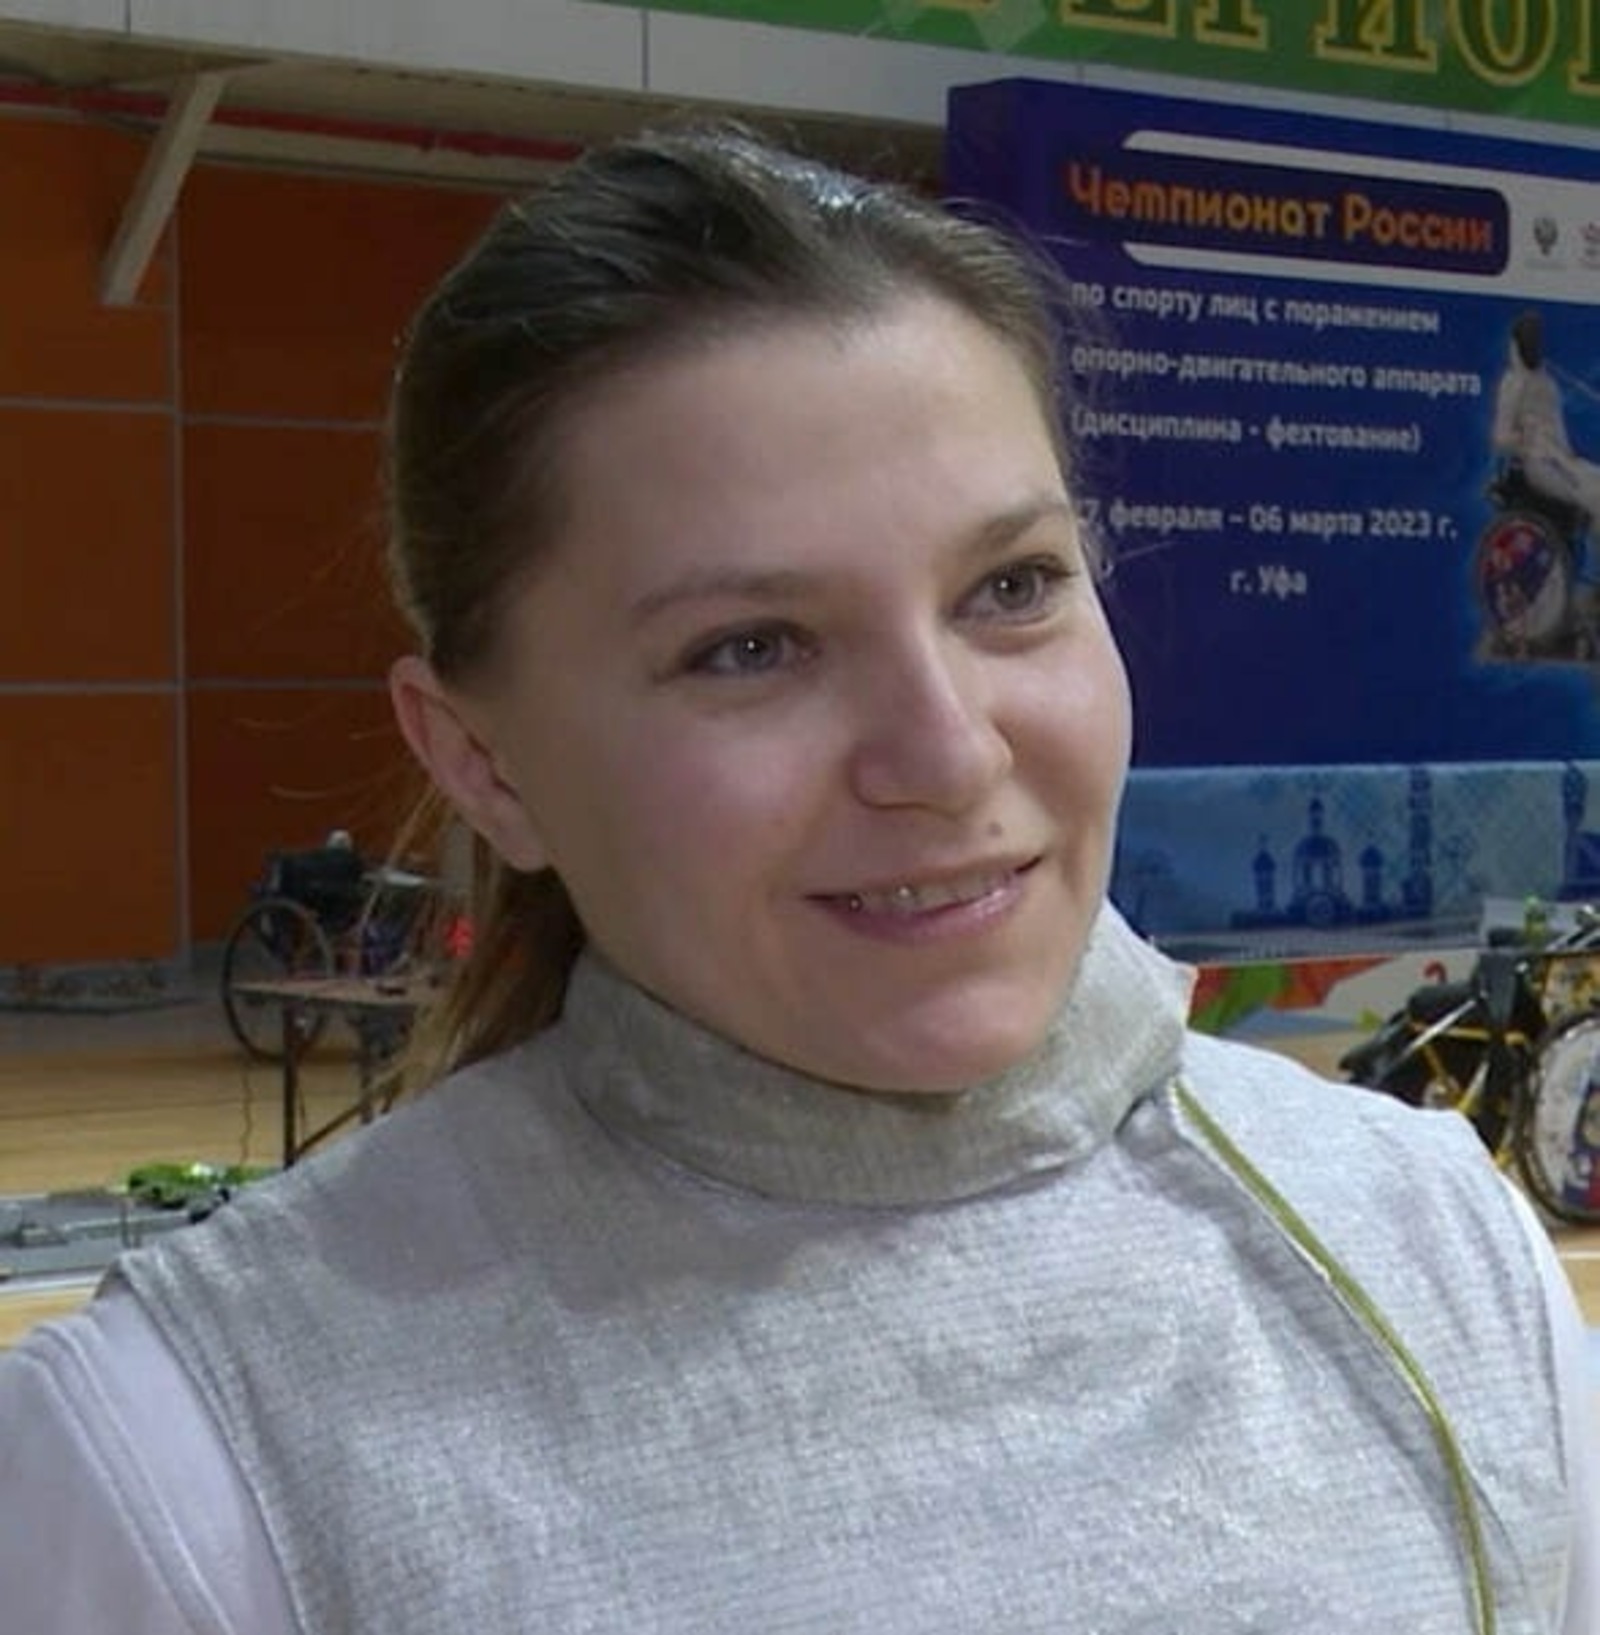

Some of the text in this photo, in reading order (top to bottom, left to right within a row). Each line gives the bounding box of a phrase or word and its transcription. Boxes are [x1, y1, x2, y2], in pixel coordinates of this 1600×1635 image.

[1068, 165, 1494, 253] Чемпионат России
[1071, 282, 1440, 334] по спорту лиц с поражением
[1071, 345, 1482, 400] опорно-двигательного аппарата
[1070, 404, 1243, 443] (дисциплина
[1264, 414, 1422, 453] фехтование)
[1108, 496, 1225, 537] февраля
[1248, 505, 1284, 533] 06
[1288, 511, 1365, 542] марта
[1369, 508, 1433, 538] 2023
[1437, 518, 1460, 540] г.
[1229, 565, 1308, 601] г. Уфа
